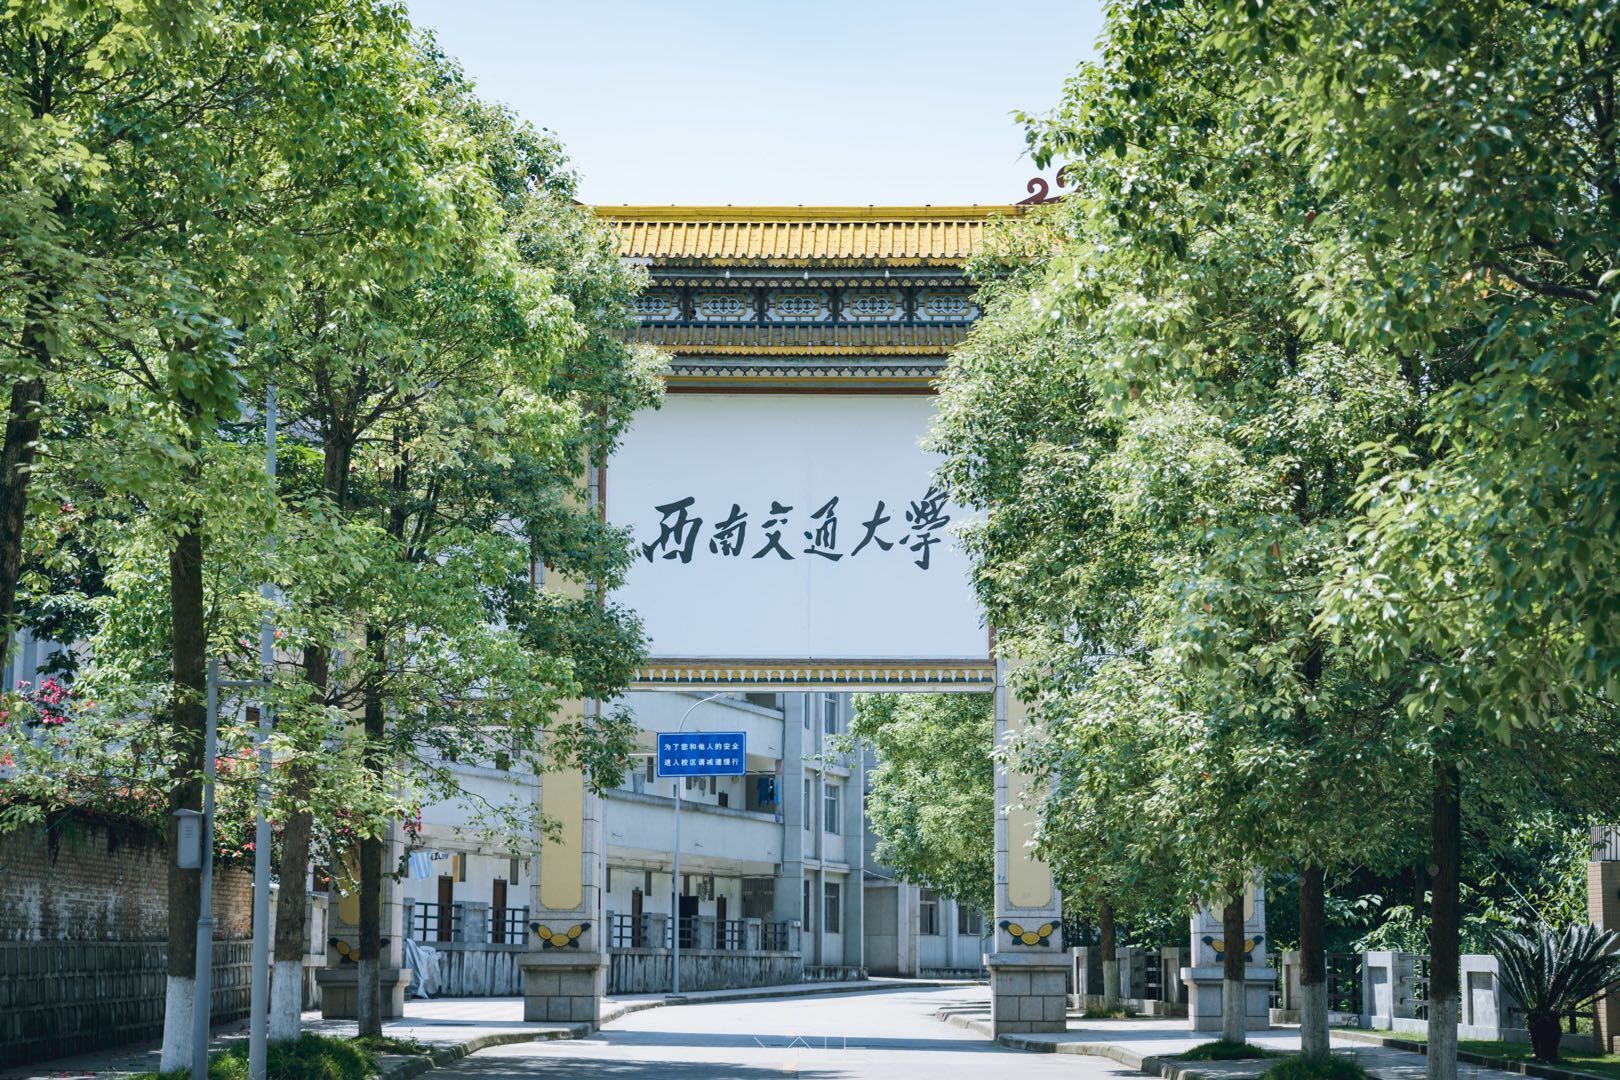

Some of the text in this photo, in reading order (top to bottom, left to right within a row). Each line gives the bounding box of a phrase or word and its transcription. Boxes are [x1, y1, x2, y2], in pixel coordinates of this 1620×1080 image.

[641, 487, 951, 570] 西南交通大學
[664, 742, 739, 751] 为了您和他人的安全
